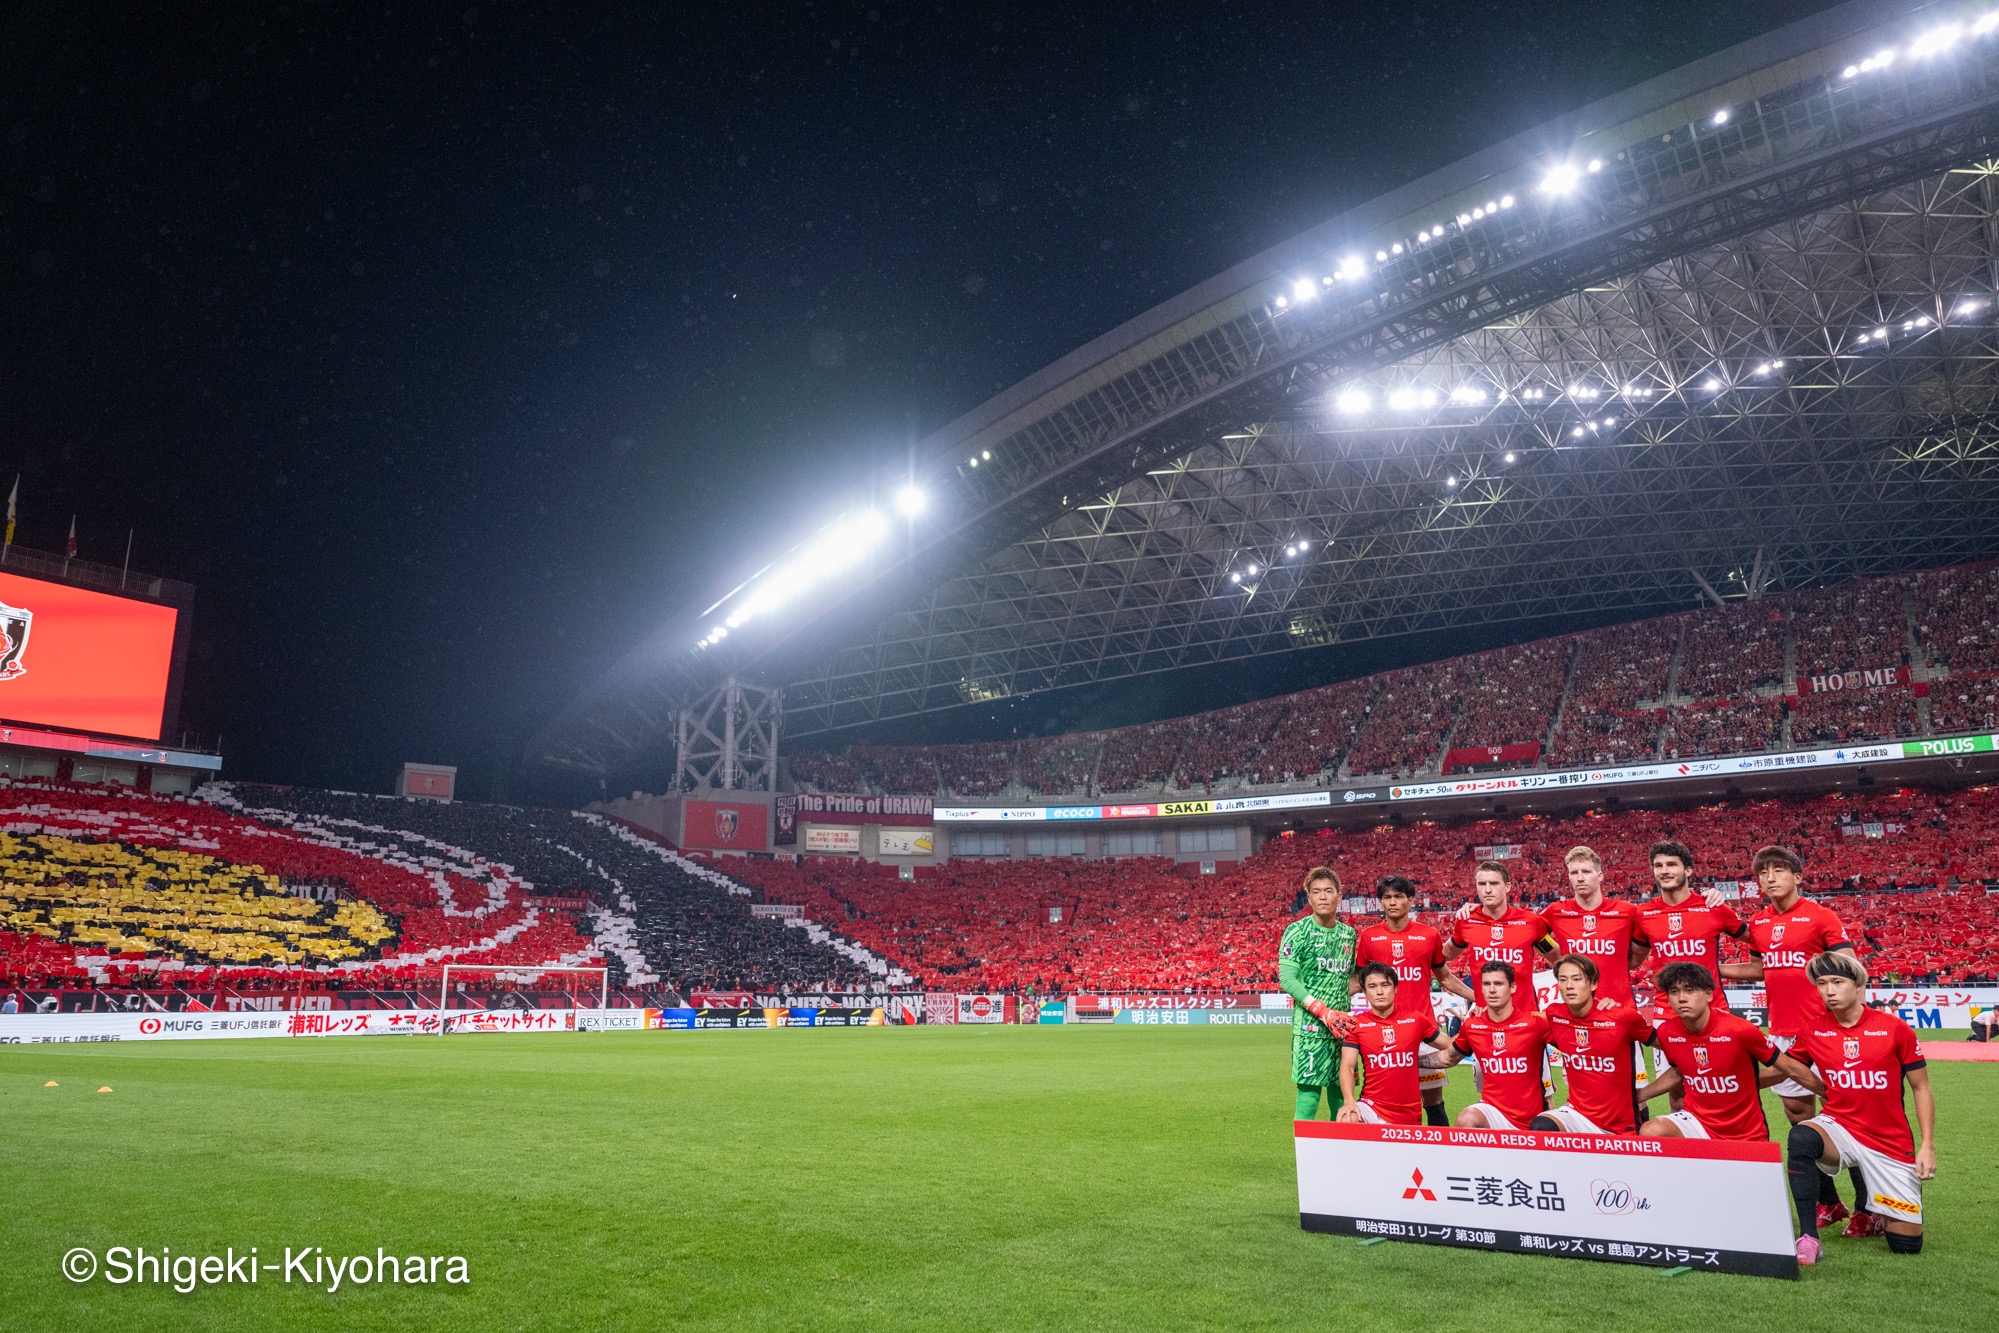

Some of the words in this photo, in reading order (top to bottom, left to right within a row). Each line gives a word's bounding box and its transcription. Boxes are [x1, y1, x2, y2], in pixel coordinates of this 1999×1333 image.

[1920, 738, 1974, 755] POLUS
[1753, 754, 1818, 768] 市原重機建設
[1852, 749, 1888, 759] 大成建設
[1520, 777, 1546, 787] キリン
[1548, 773, 1588, 785] 一番搾り
[1356, 792, 1376, 800] SPD
[798, 794, 823, 812] The
[826, 795, 864, 814] Pride
[866, 797, 881, 814] of
[1165, 802, 1208, 814] SAKAI
[1054, 808, 1095, 818] ecoco
[1864, 823, 1882, 832] 310
[1718, 882, 1737, 891] 215
[1350, 898, 1365, 906] 214
[1566, 939, 1616, 955] POLUS
[1654, 939, 1706, 958] POLUS
[1473, 947, 1524, 964] POLUS
[1098, 996, 1237, 1009] 浦和レッズコレクション
[287, 1013, 372, 1034] 浦和レッズ
[580, 1017, 600, 1027] REX
[604, 1017, 638, 1027] TICKET
[650, 1018, 661, 1028] EY
[695, 1018, 706, 1027] EY
[737, 1018, 748, 1027] EY
[777, 1017, 787, 1026] EY
[815, 1017, 824, 1026] EY
[850, 1017, 859, 1025] EY
[1131, 1010, 1189, 1024] 明治安田
[1210, 1013, 1244, 1024] ROUTE
[164, 1020, 203, 1032] MUFG
[1368, 1052, 1414, 1069] POLUS
[1481, 1057, 1528, 1074] POLUS
[1562, 1052, 1616, 1073] POLUS
[1684, 1075, 1740, 1094] POLUS
[1825, 1070, 1888, 1090] POLUS
[1381, 1128, 1443, 1142] 2025.9.20
[1449, 1131, 1498, 1145] URAWA
[1501, 1134, 1537, 1146] REDS
[1544, 1136, 1592, 1149] MATCH
[1595, 1139, 1663, 1154] PARTNER
[1446, 1176, 1565, 1212] 三菱食品
[1595, 1188, 1651, 1211] 100th
[1881, 1197, 1920, 1213] DHL
[1455, 1229, 1497, 1245] 第30節
[1520, 1234, 1585, 1252] 浦和レッズ
[1588, 1244, 1604, 1254] vs
[1608, 1242, 1720, 1266] 鹿島アントラーズ
